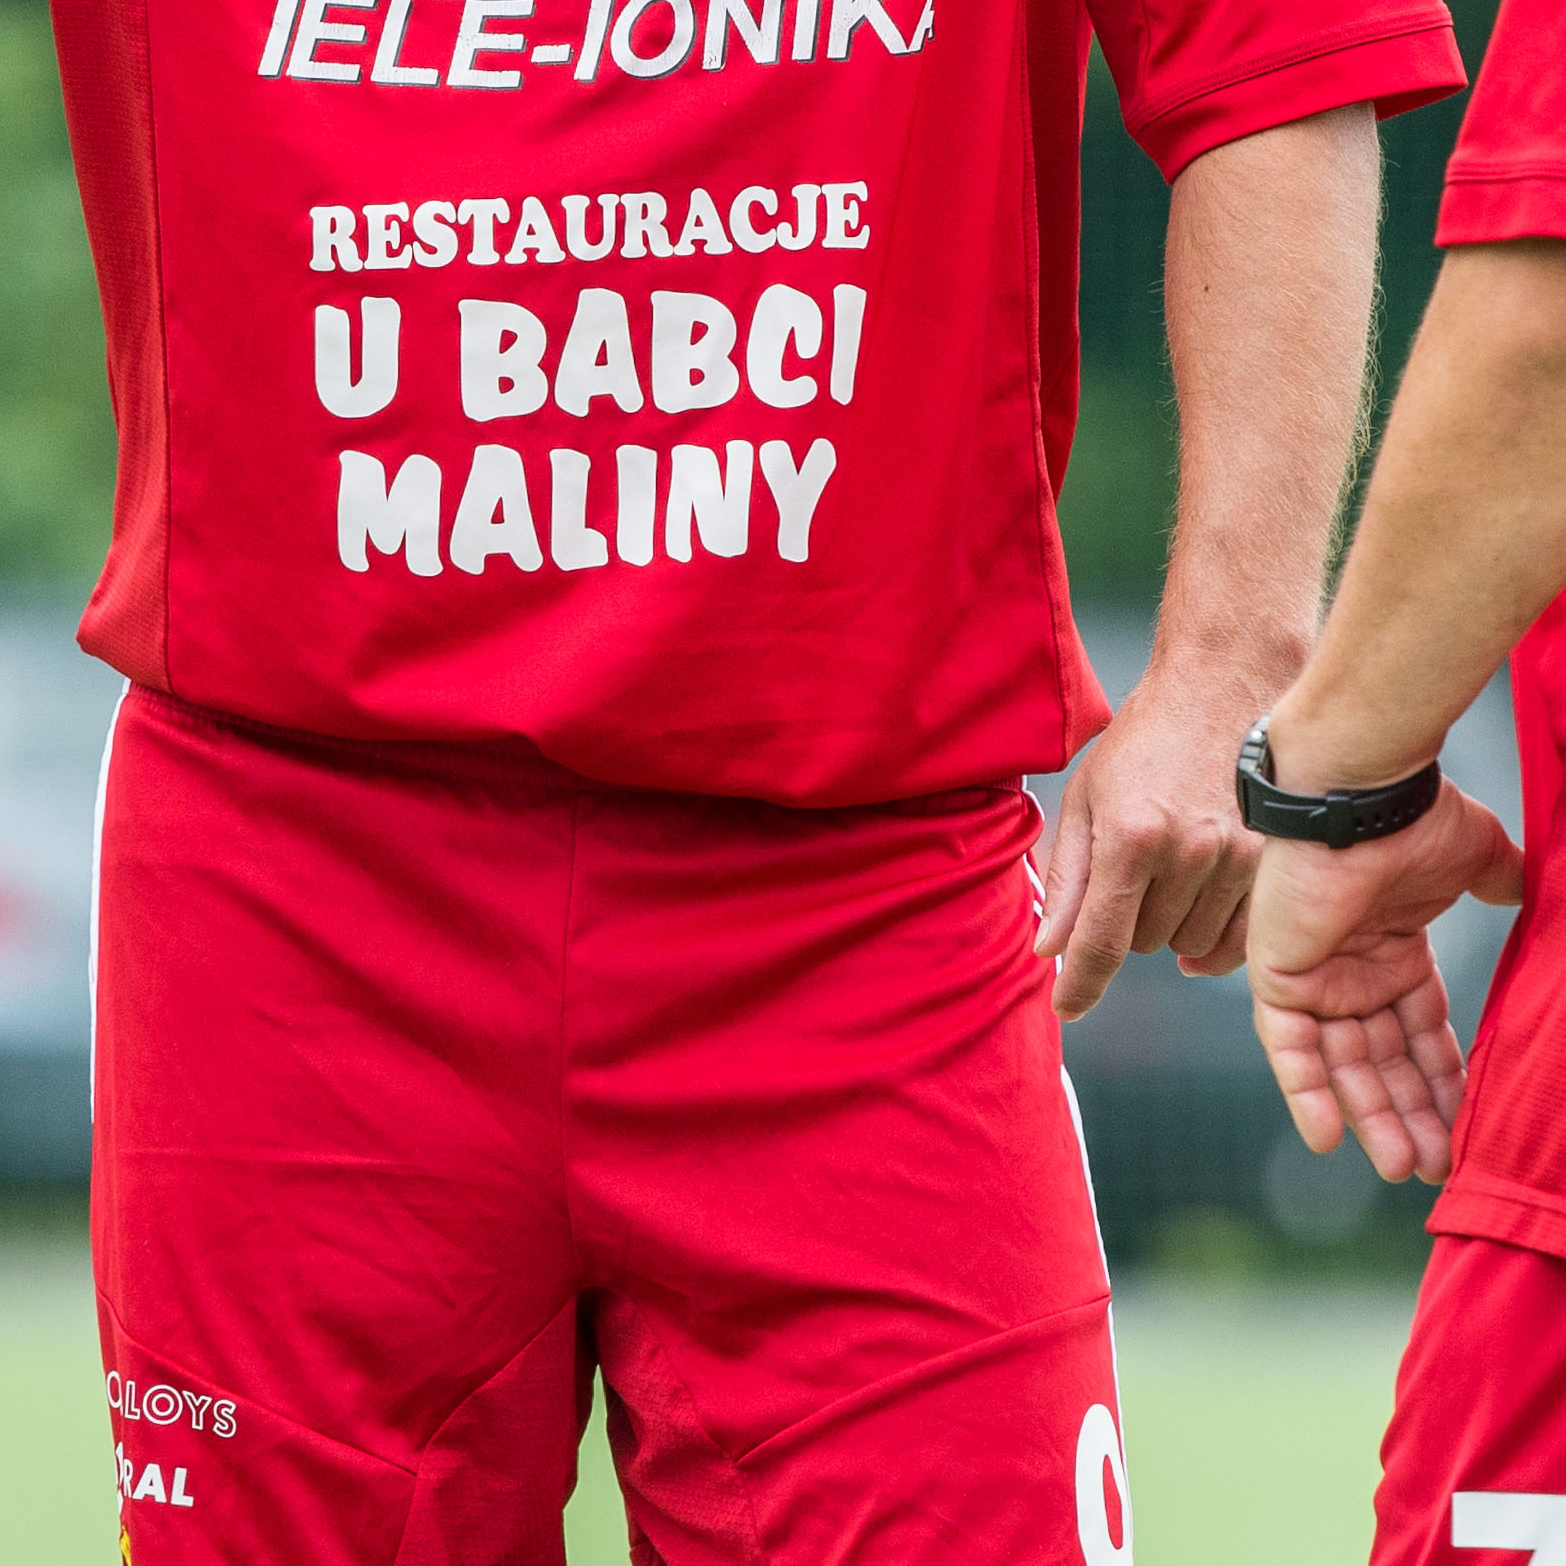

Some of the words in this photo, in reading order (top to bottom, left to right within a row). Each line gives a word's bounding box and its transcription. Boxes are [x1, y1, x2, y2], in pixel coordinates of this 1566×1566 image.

[309, 180, 870, 272] RESTAURACJE
[314, 296, 402, 419] U
[458, 283, 867, 423] BABCI
[337, 438, 837, 577] MALINY
